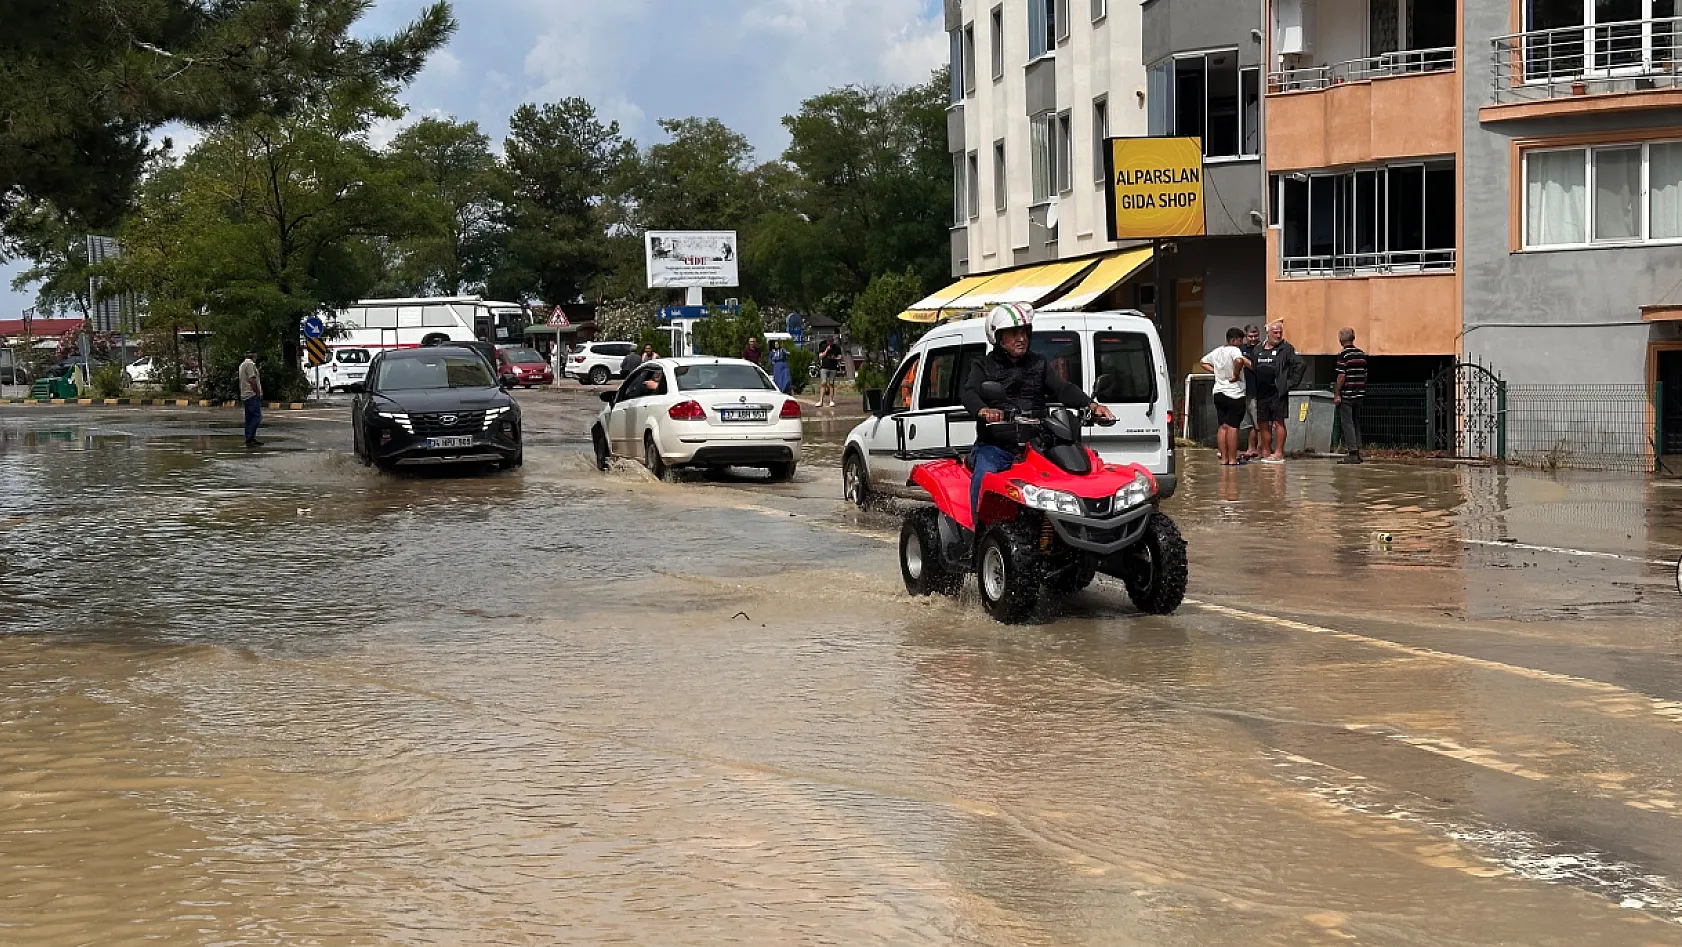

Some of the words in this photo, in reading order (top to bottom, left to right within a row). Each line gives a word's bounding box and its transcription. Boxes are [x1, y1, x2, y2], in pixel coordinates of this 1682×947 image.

[1116, 168, 1199, 185] ALPARSLAN
[1122, 193, 1155, 209] GIDA
[1159, 192, 1196, 208] SHOP
